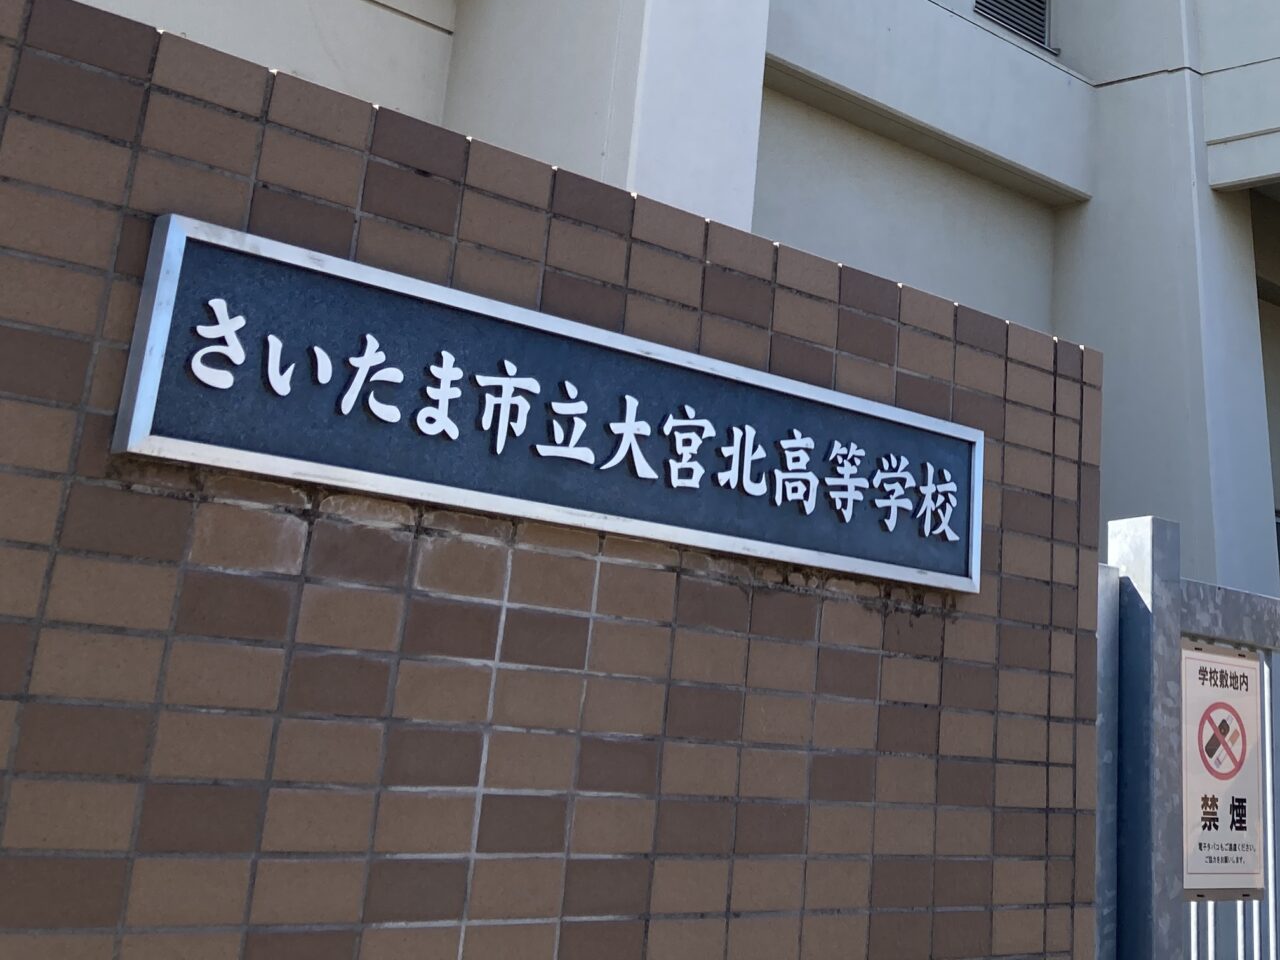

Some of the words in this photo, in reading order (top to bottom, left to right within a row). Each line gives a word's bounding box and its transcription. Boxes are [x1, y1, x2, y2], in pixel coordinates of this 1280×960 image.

[190, 298, 960, 542] さいたま市立大宮北高等学校
[1198, 666, 1248, 692] 学校敷地内
